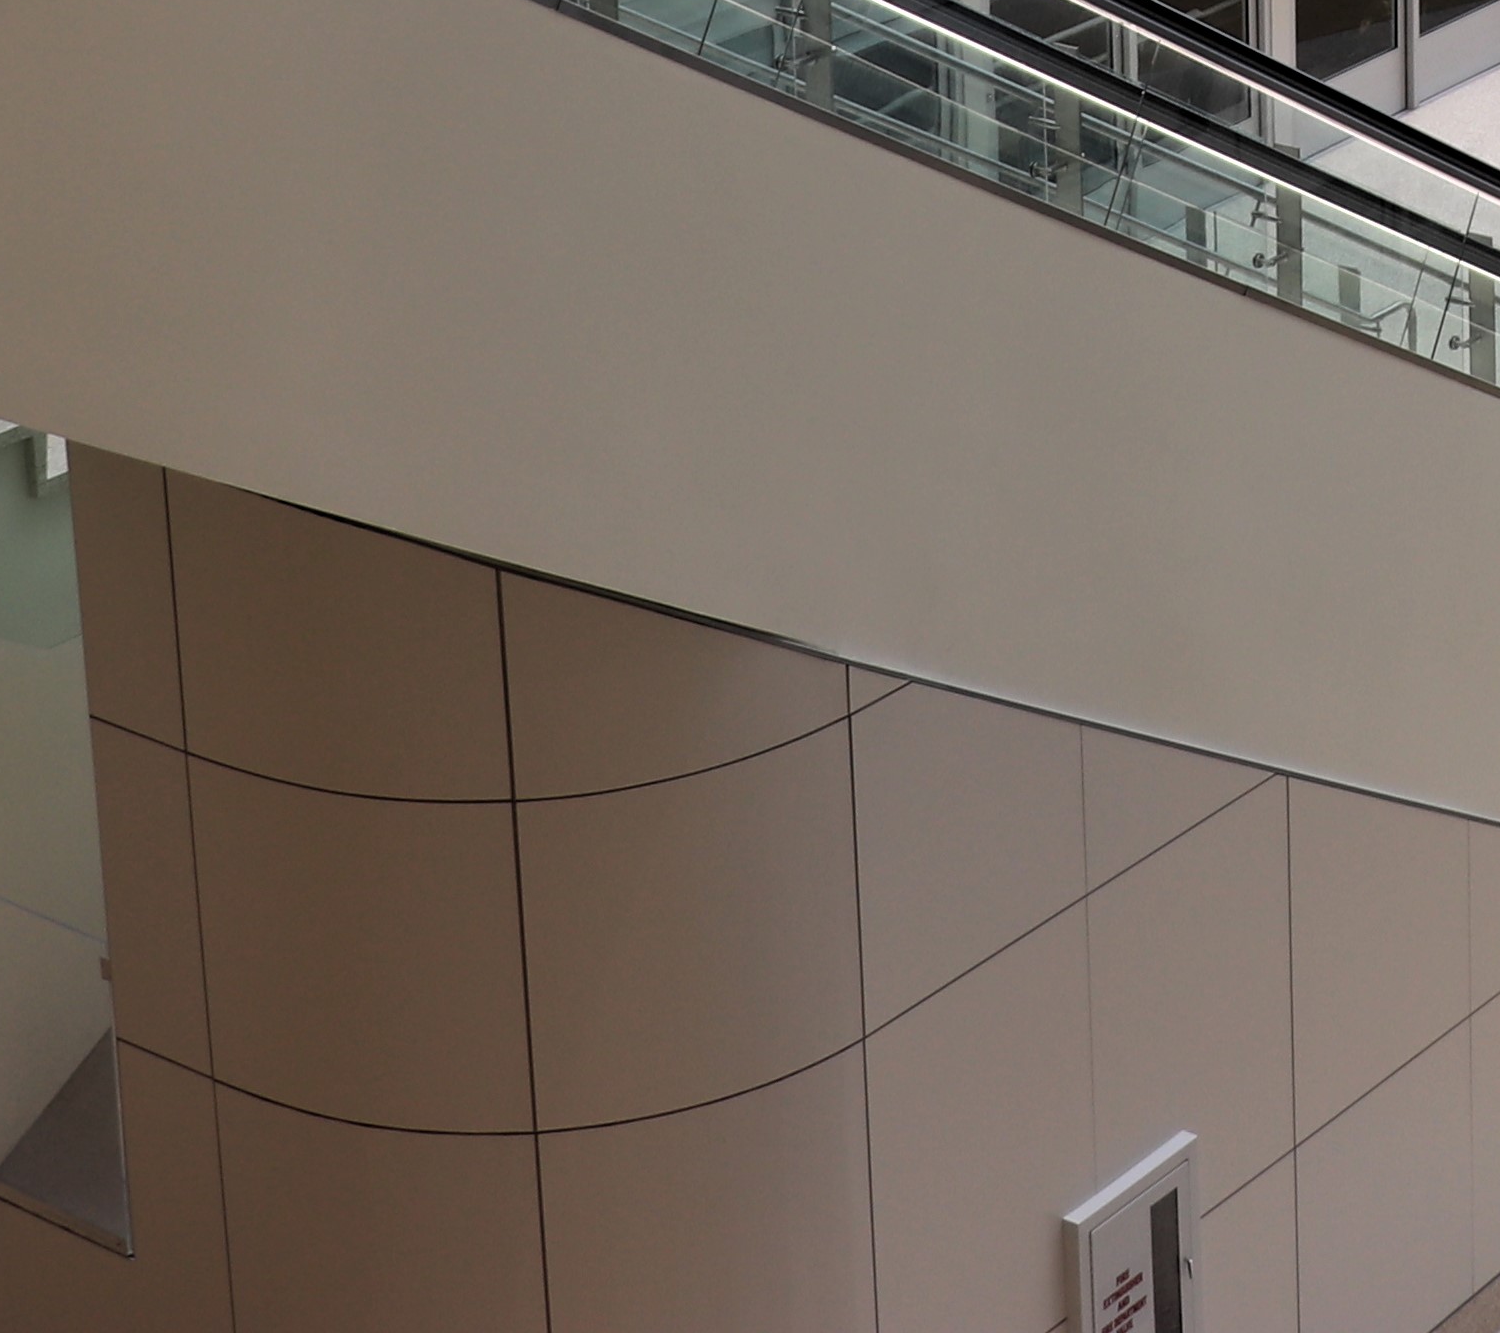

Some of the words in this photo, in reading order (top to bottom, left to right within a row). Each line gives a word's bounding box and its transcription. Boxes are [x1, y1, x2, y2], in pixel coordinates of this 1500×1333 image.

[1103, 1271, 1144, 1310] EXTINGUISHER
[1116, 1268, 1130, 1287] FIRE
[1114, 1294, 1147, 1328] DEPARTMENT
[1118, 1295, 1130, 1312] AND
